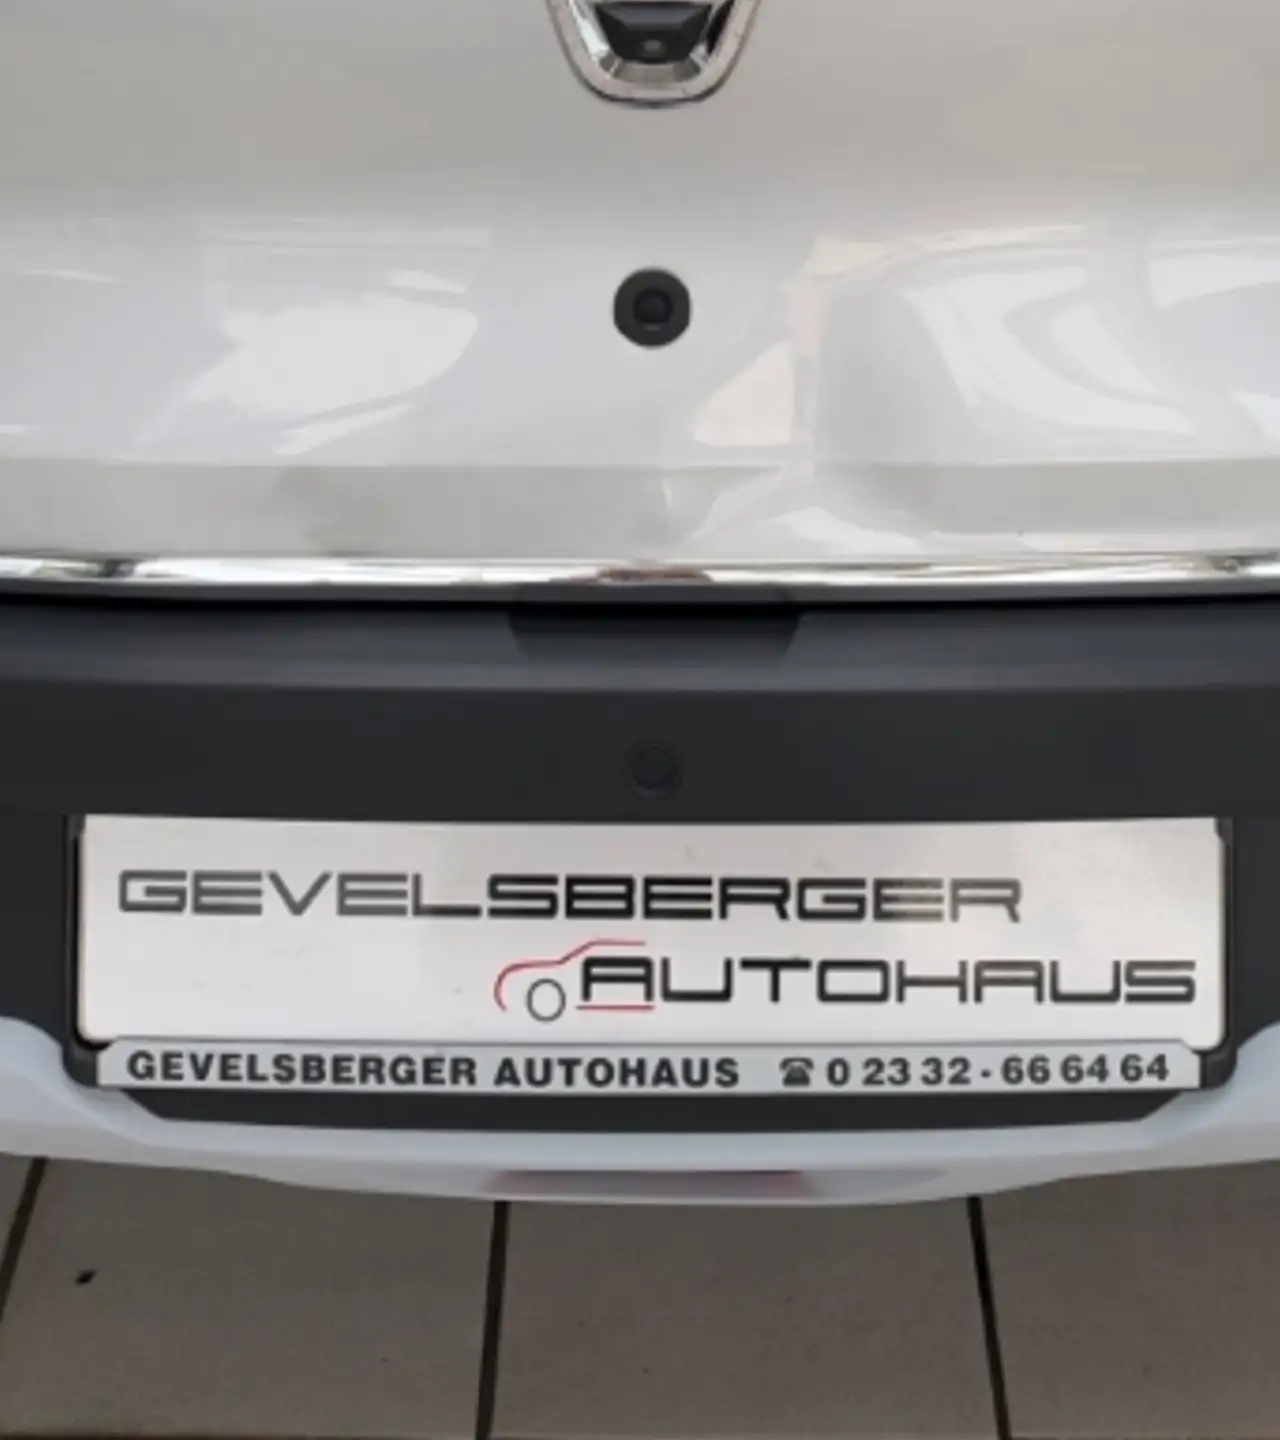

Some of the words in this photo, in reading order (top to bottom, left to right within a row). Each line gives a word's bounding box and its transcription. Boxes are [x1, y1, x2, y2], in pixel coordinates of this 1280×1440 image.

[119, 870, 1021, 923] GEVELSBERGER
[580, 955, 1196, 1004] AUTOHAUS
[125, 1049, 478, 1085] GEVELSBERGER
[493, 1056, 740, 1089] AUTOHAUS
